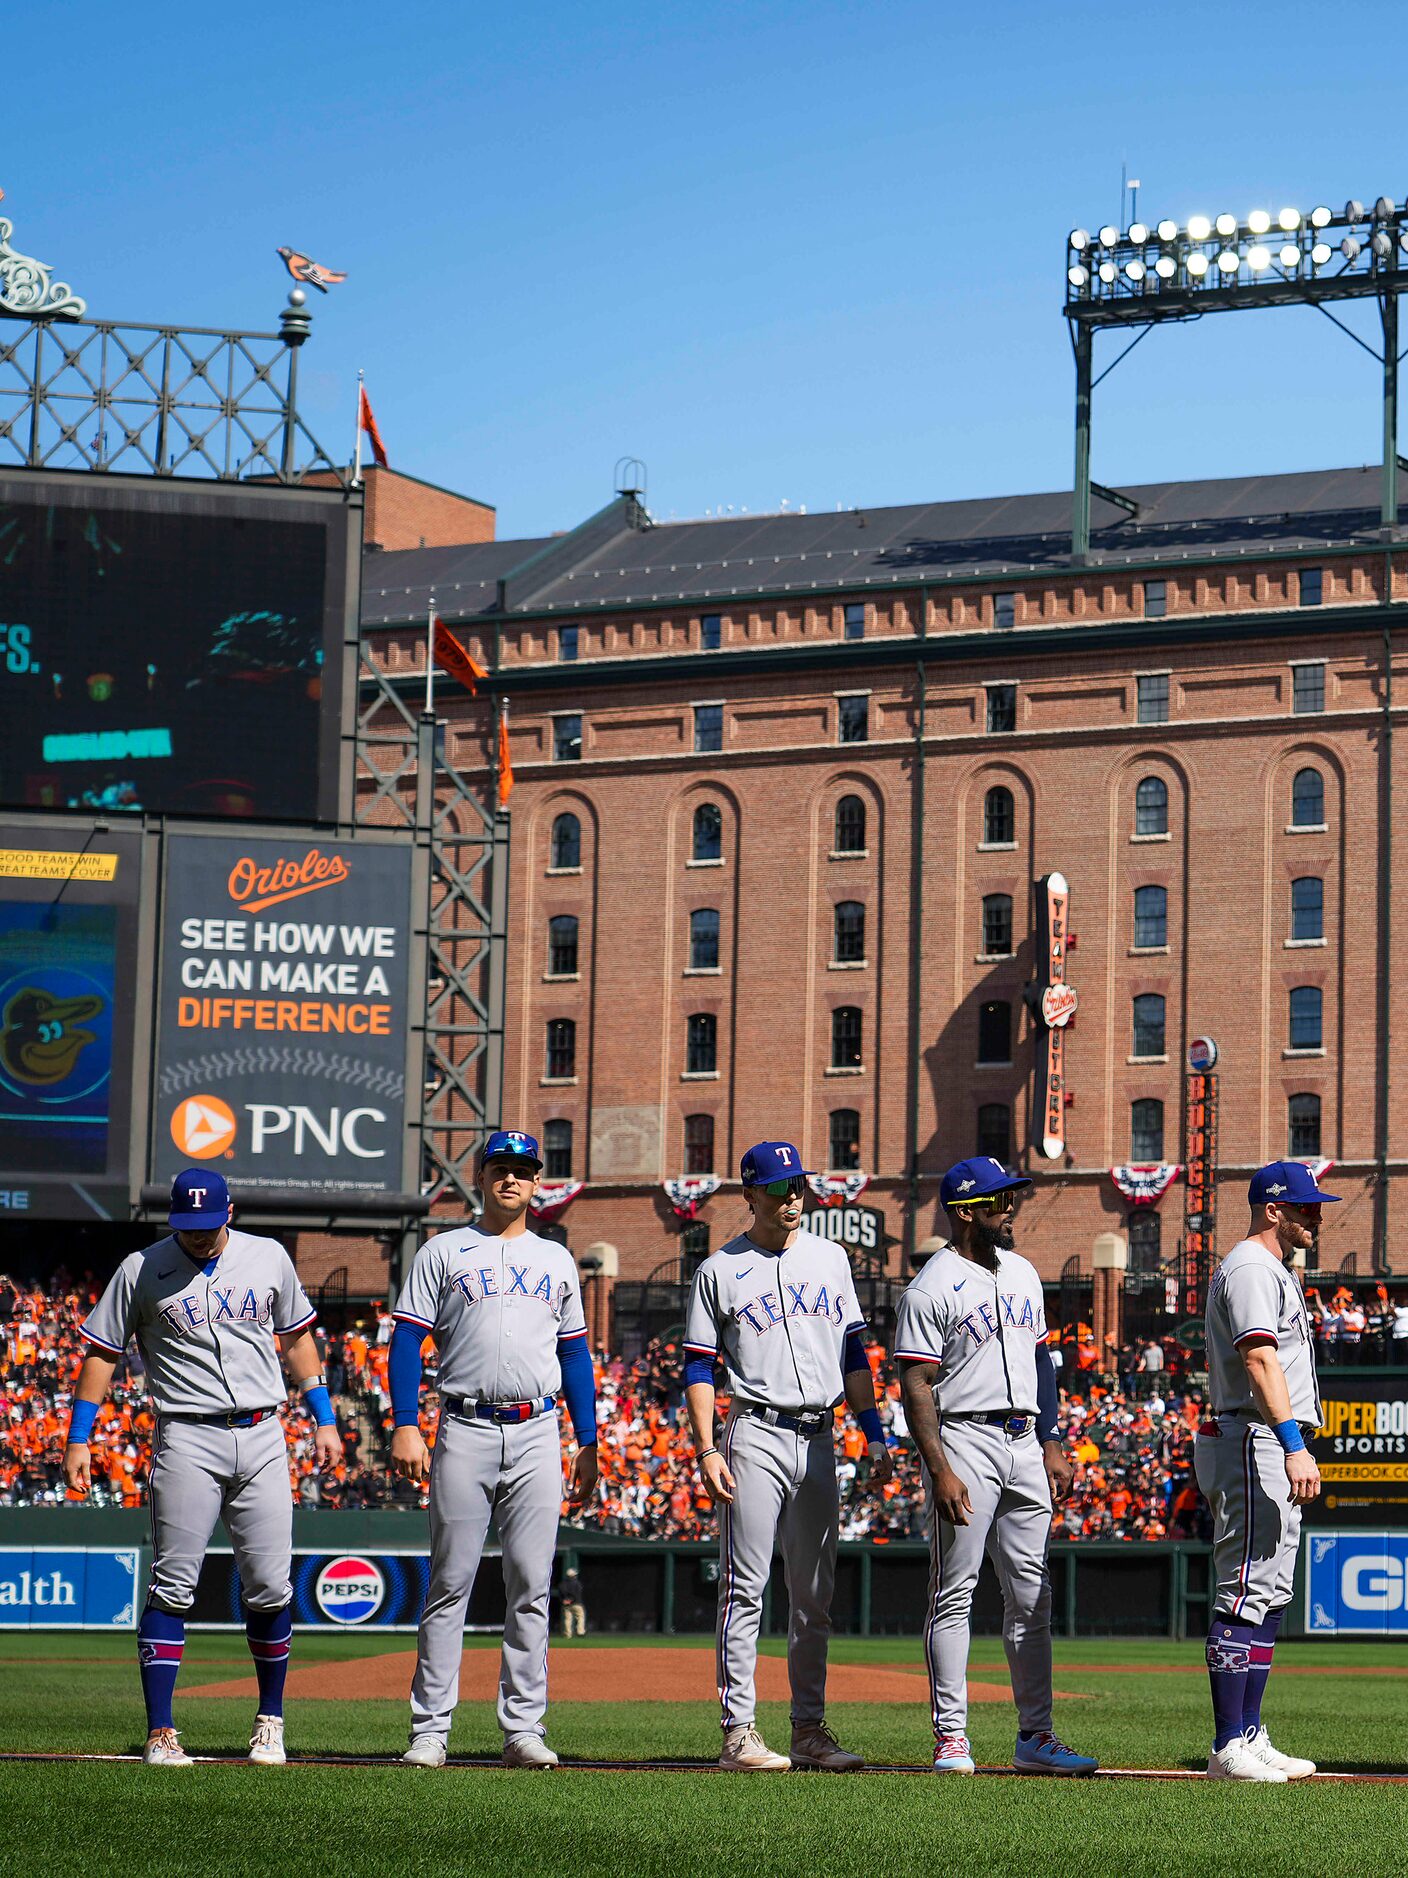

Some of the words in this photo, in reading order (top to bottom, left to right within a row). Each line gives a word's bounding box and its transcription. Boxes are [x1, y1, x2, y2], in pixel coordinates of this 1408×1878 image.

[0, 623, 40, 674] S.
[0, 853, 33, 863] OOD
[38, 855, 74, 865] TEAMS
[78, 856, 101, 865] WIN
[29, 865, 65, 876] TEAMS
[228, 849, 348, 908] Orioles
[181, 918, 247, 952] SEE
[254, 921, 336, 955] HOW
[340, 925, 396, 958] WE
[1053, 898, 1064, 979] TEAM
[181, 957, 252, 991] CAN
[261, 960, 359, 995] MAKE
[363, 965, 390, 996] A
[178, 997, 392, 1036] DIFFERENCE
[1049, 1032, 1062, 1134] STORE
[245, 1104, 387, 1158] PNC
[775, 1146, 792, 1167] T
[188, 1188, 207, 1208] T
[734, 1281, 847, 1337] TEXAS
[1333, 1437, 1406, 1454] SPORTS
[322, 1583, 378, 1596] PEPSI
